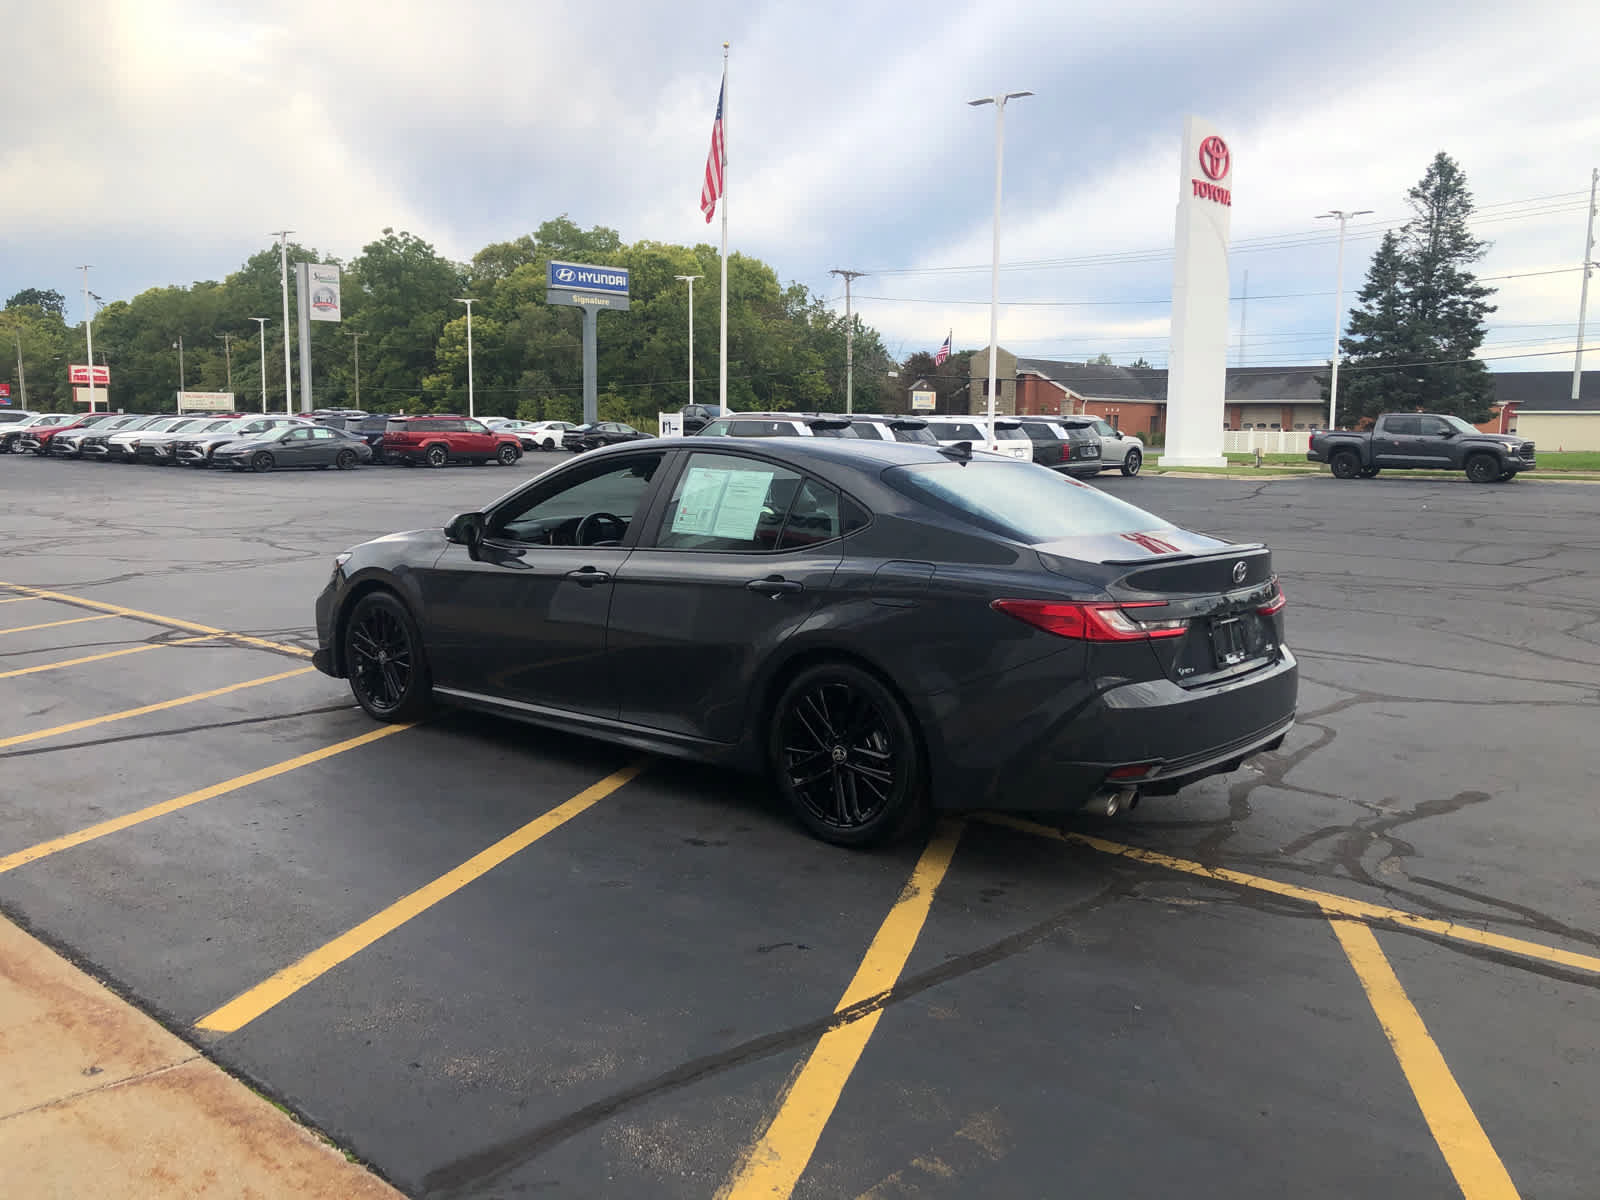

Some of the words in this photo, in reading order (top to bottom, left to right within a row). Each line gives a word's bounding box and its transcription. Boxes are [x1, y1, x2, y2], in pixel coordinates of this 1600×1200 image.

[1191, 178, 1231, 207] TOYOTA
[578, 271, 627, 287] HYUNDAI
[572, 294, 609, 306] Signature
